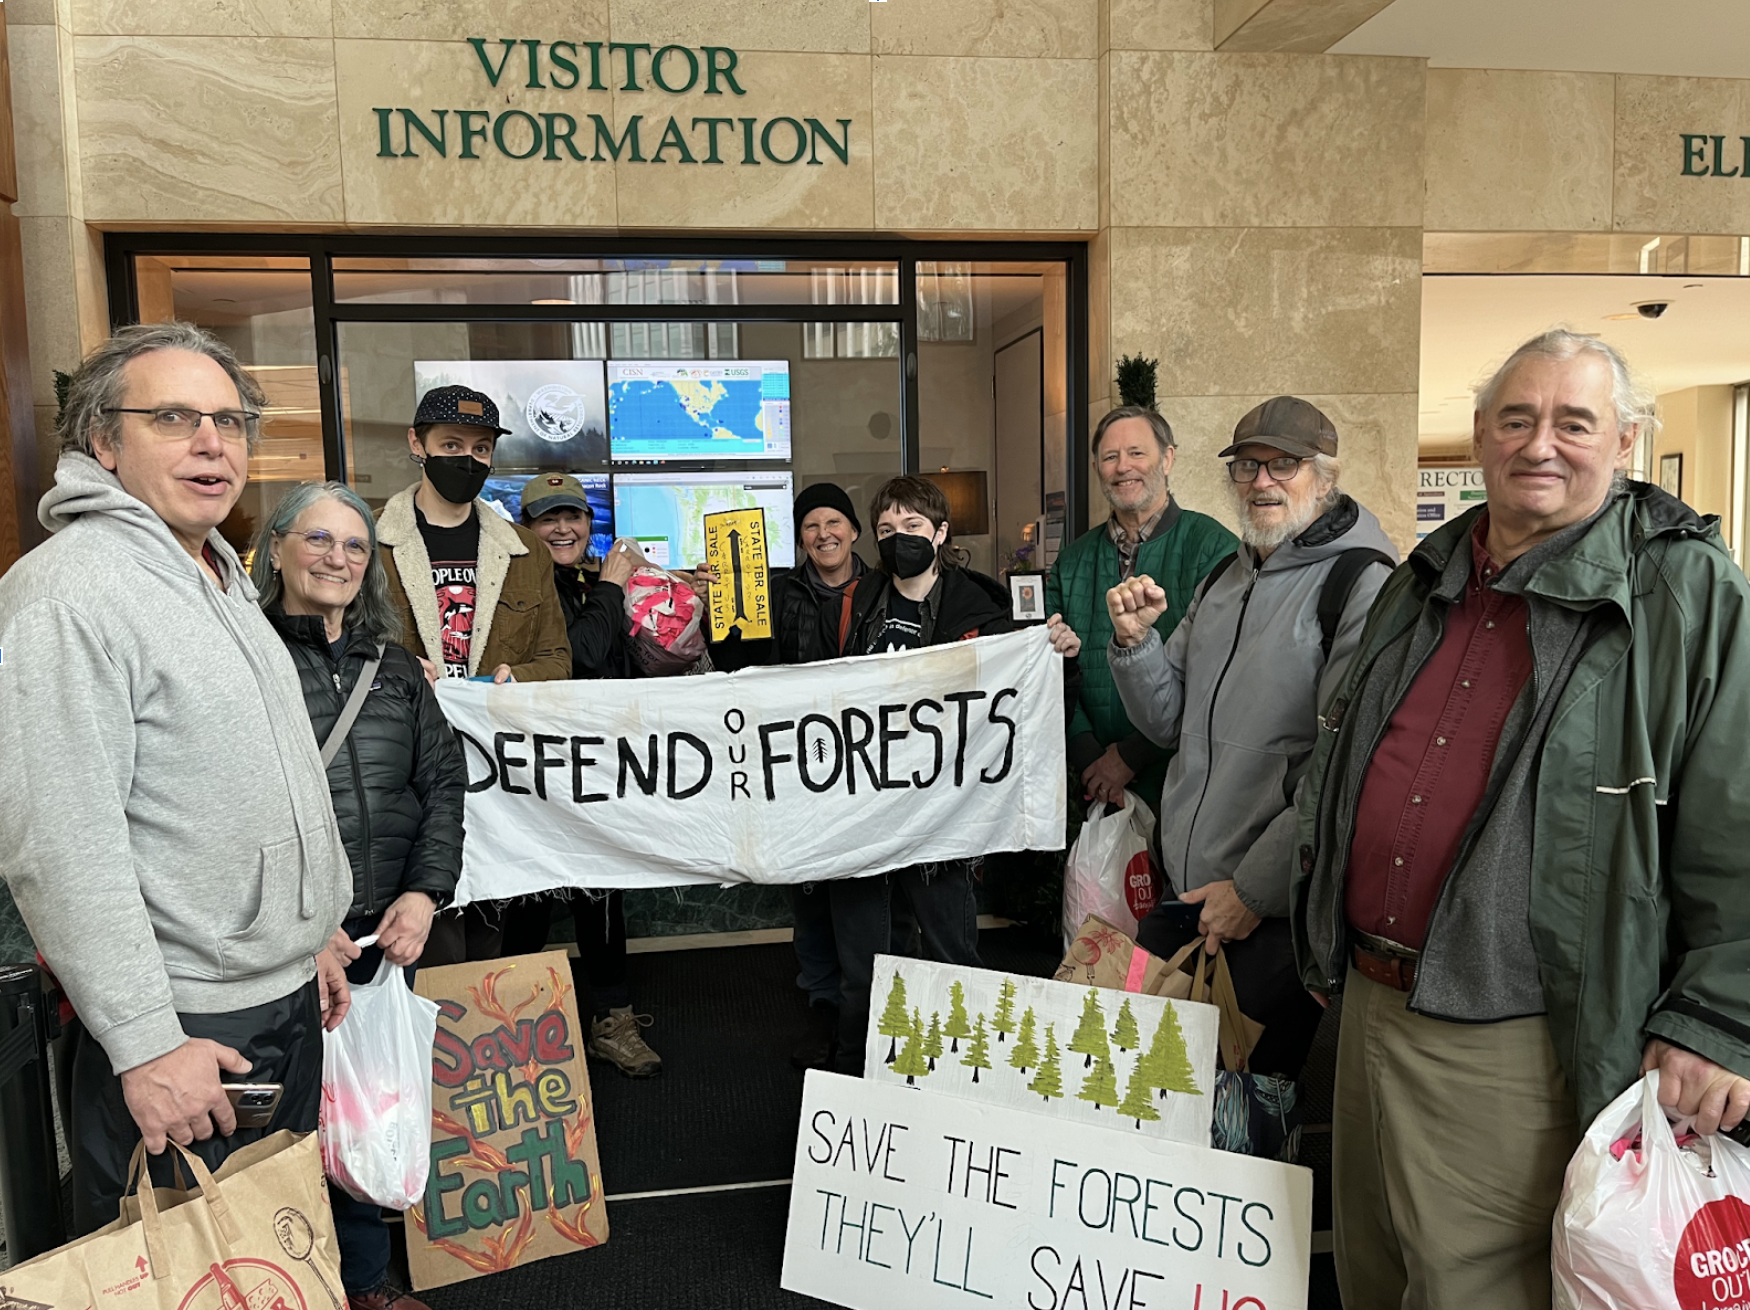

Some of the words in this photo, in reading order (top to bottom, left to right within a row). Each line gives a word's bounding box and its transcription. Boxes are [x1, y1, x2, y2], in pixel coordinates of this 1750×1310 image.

[467, 37, 747, 95] VISITOR
[372, 107, 852, 166] INFORMATION
[709, 526, 719, 557] SALE
[750, 522, 762, 560] STATE
[754, 564, 763, 591] TBR.
[713, 590, 724, 628] STATE
[755, 595, 766, 626] SALE
[452, 726, 713, 803] DEFEND
[724, 708, 751, 800] OUR
[759, 688, 1018, 800] FORESTS
[433, 999, 574, 1087] Save
[450, 1068, 577, 1139] the
[425, 1118, 592, 1241] Earth
[808, 1110, 909, 1183] SAVE
[943, 1135, 1022, 1210] THE
[1049, 1159, 1274, 1268] FORESTS
[815, 1189, 993, 1300] THEY'LL
[1028, 1246, 1165, 1310] SAVE
[128, 1282, 140, 1290] OUT
